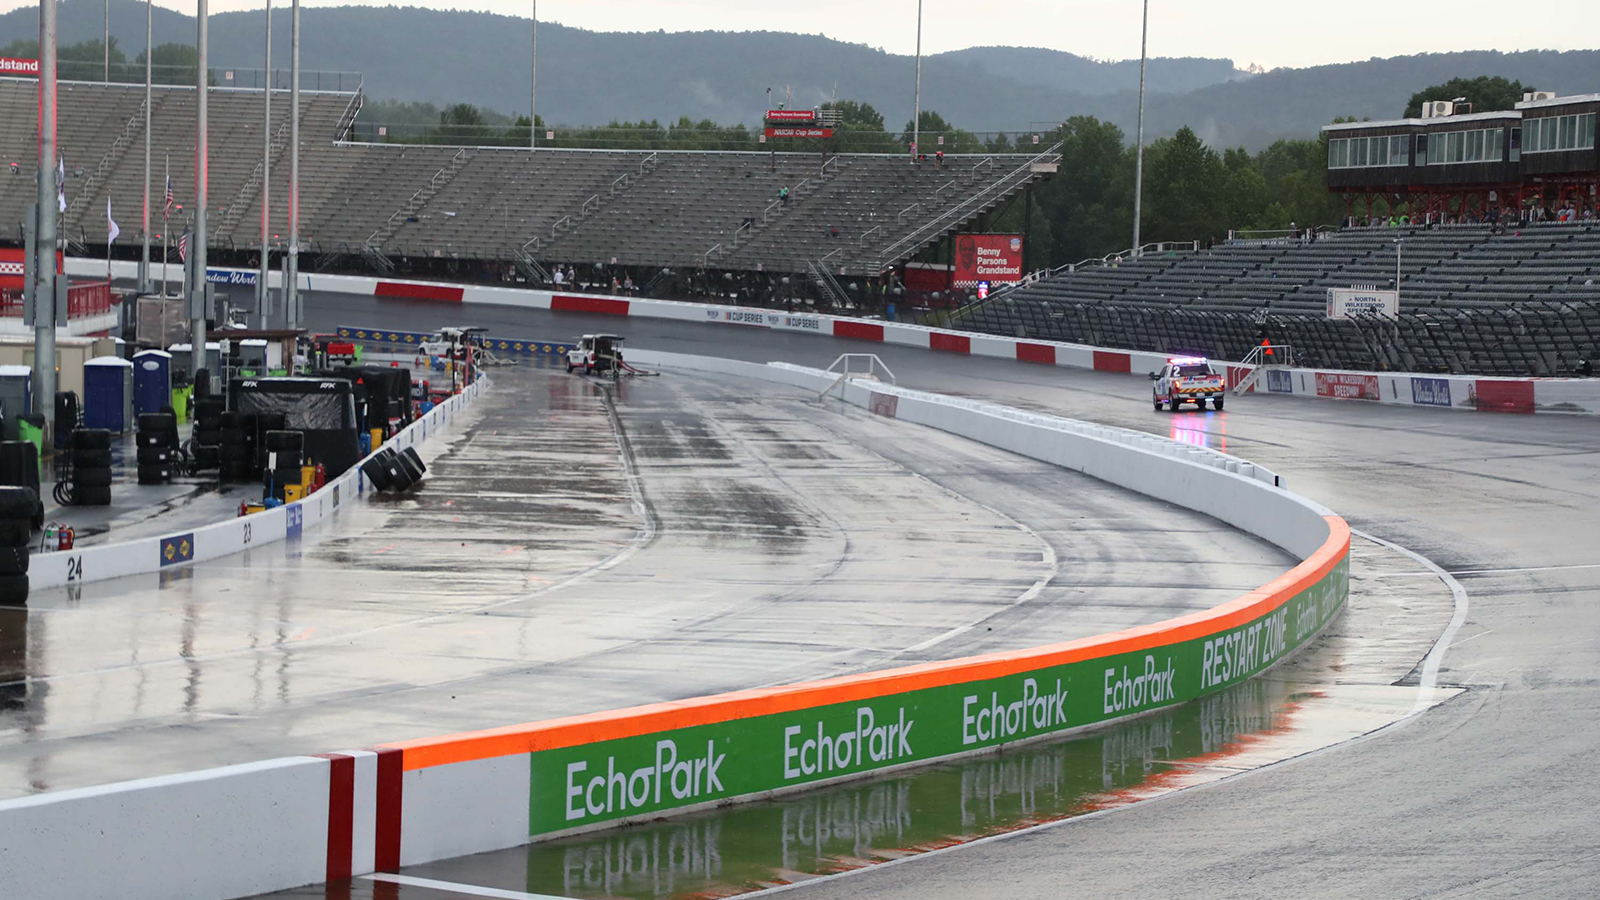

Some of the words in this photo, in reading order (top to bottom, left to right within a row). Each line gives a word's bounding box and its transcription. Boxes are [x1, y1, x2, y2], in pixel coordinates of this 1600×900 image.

[977, 247, 1001, 257] Benny
[977, 256, 1008, 265] Parsons
[977, 266, 1020, 275] Grandstand
[732, 312, 744, 321] CUP
[744, 313, 763, 324] SERIES
[792, 318, 802, 327] CUP
[802, 319, 820, 330] SERIES
[1174, 366, 1180, 376] 2
[1333, 384, 1359, 397] SPEEDWAY
[1414, 379, 1433, 402] Window
[1432, 380, 1449, 404] World
[244, 524, 251, 543] 23
[68, 556, 82, 581] 24
[565, 740, 726, 821] EchoPark
[784, 706, 914, 780] EchoPark
[962, 678, 1068, 745] EchoPark
[1103, 655, 1175, 714] EchoPark
[1201, 622, 1263, 689] RESTART
[1262, 606, 1288, 664] ZONE
